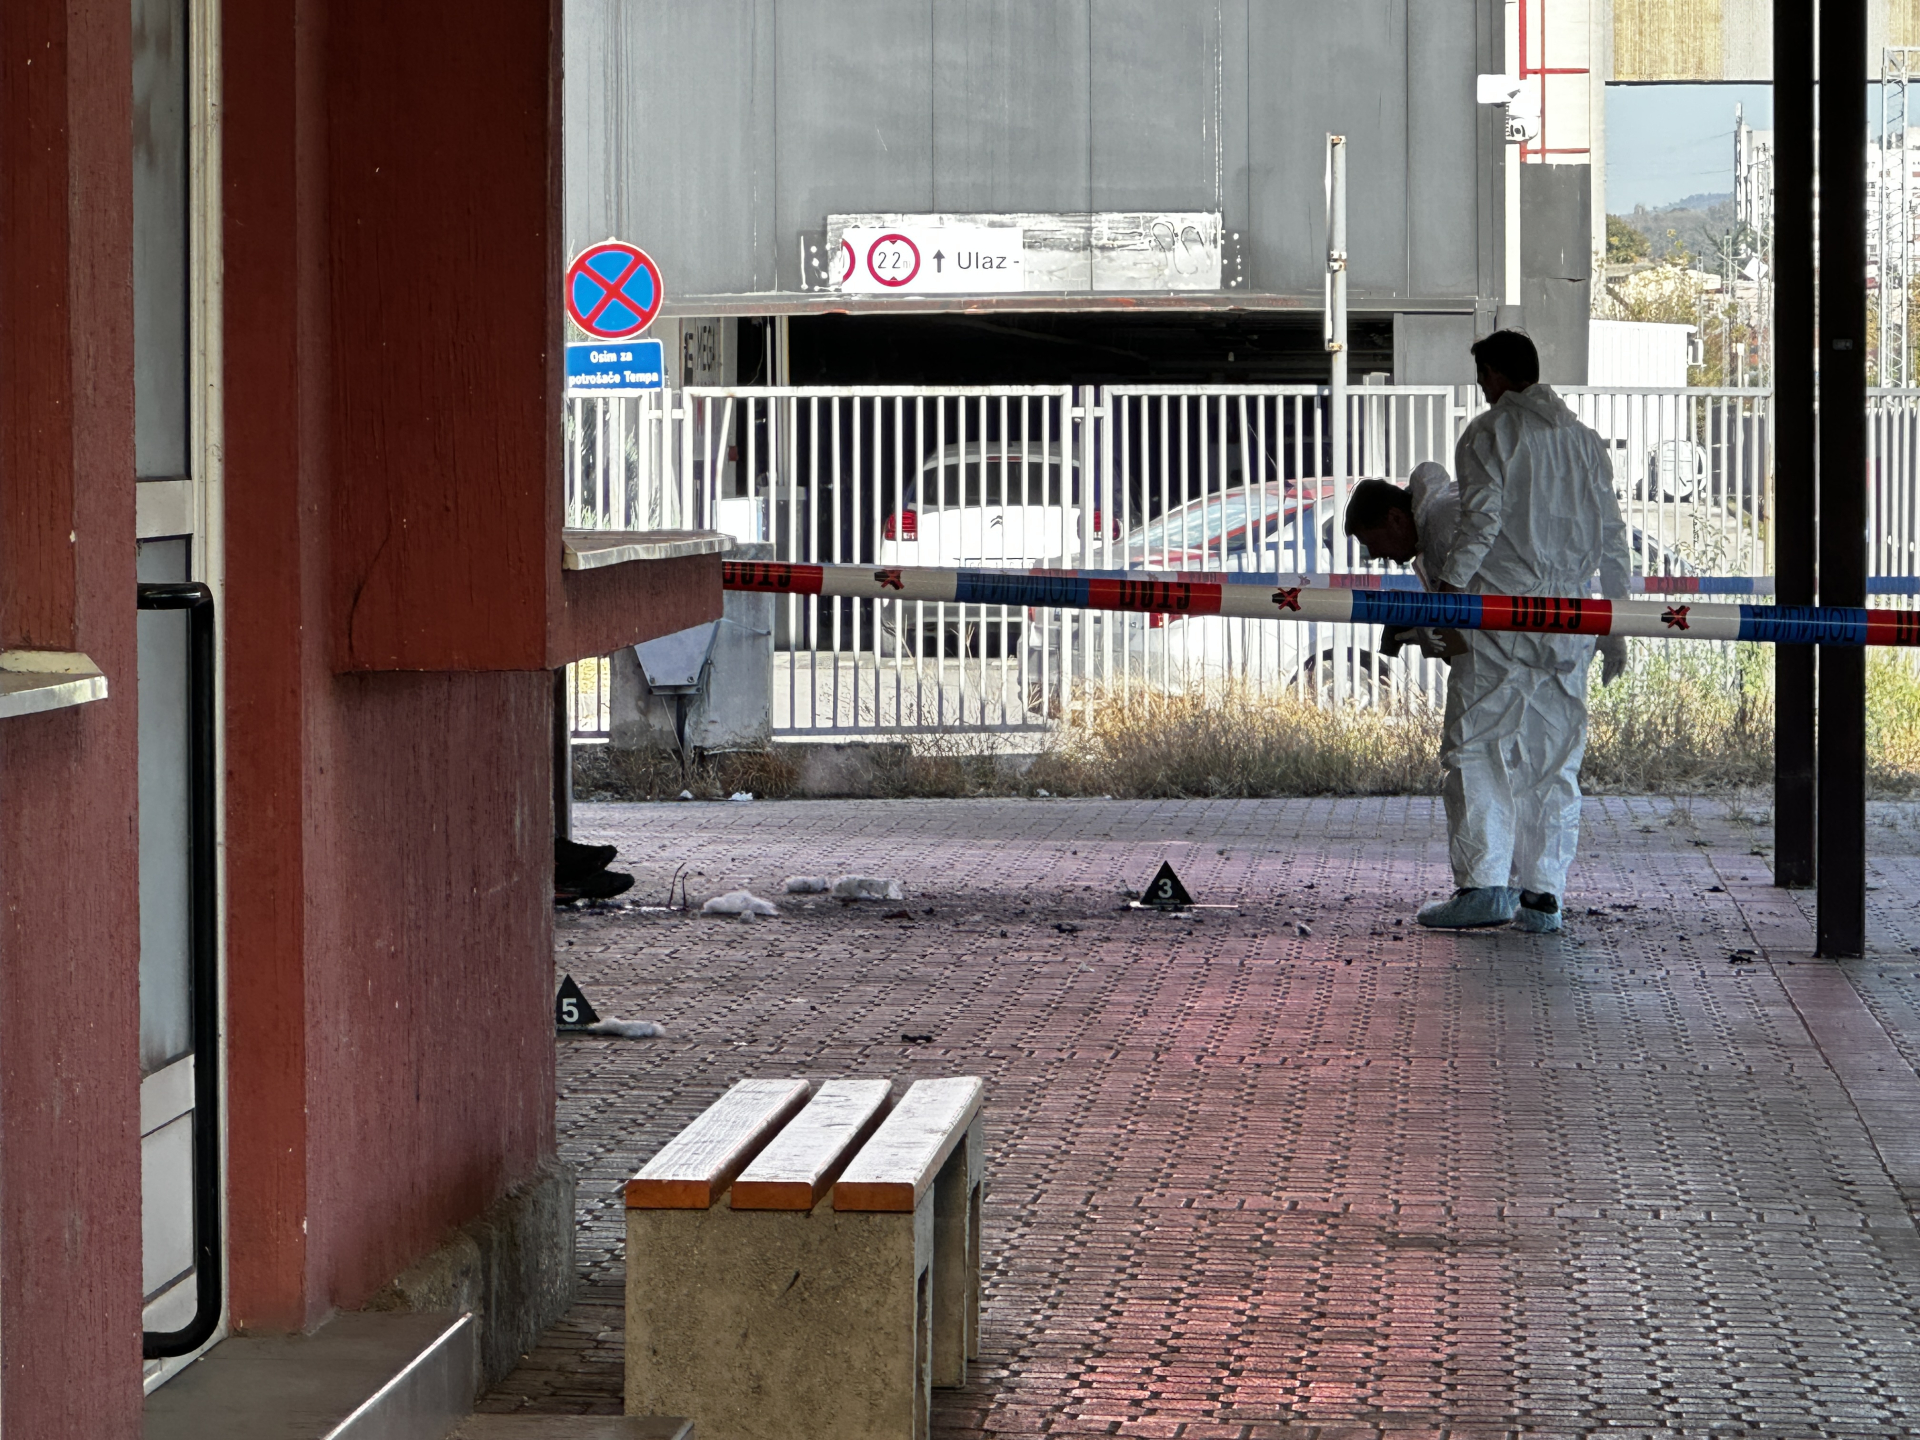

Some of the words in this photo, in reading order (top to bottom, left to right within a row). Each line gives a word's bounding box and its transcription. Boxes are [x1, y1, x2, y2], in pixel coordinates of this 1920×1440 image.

[957, 251, 1007, 270] Ulaz
[589, 350, 618, 364] Osim
[620, 351, 633, 362] za
[568, 371, 621, 388] potrošače
[623, 370, 659, 385] Tempa
[1158, 878, 1173, 898] 3
[562, 997, 579, 1023] 5
